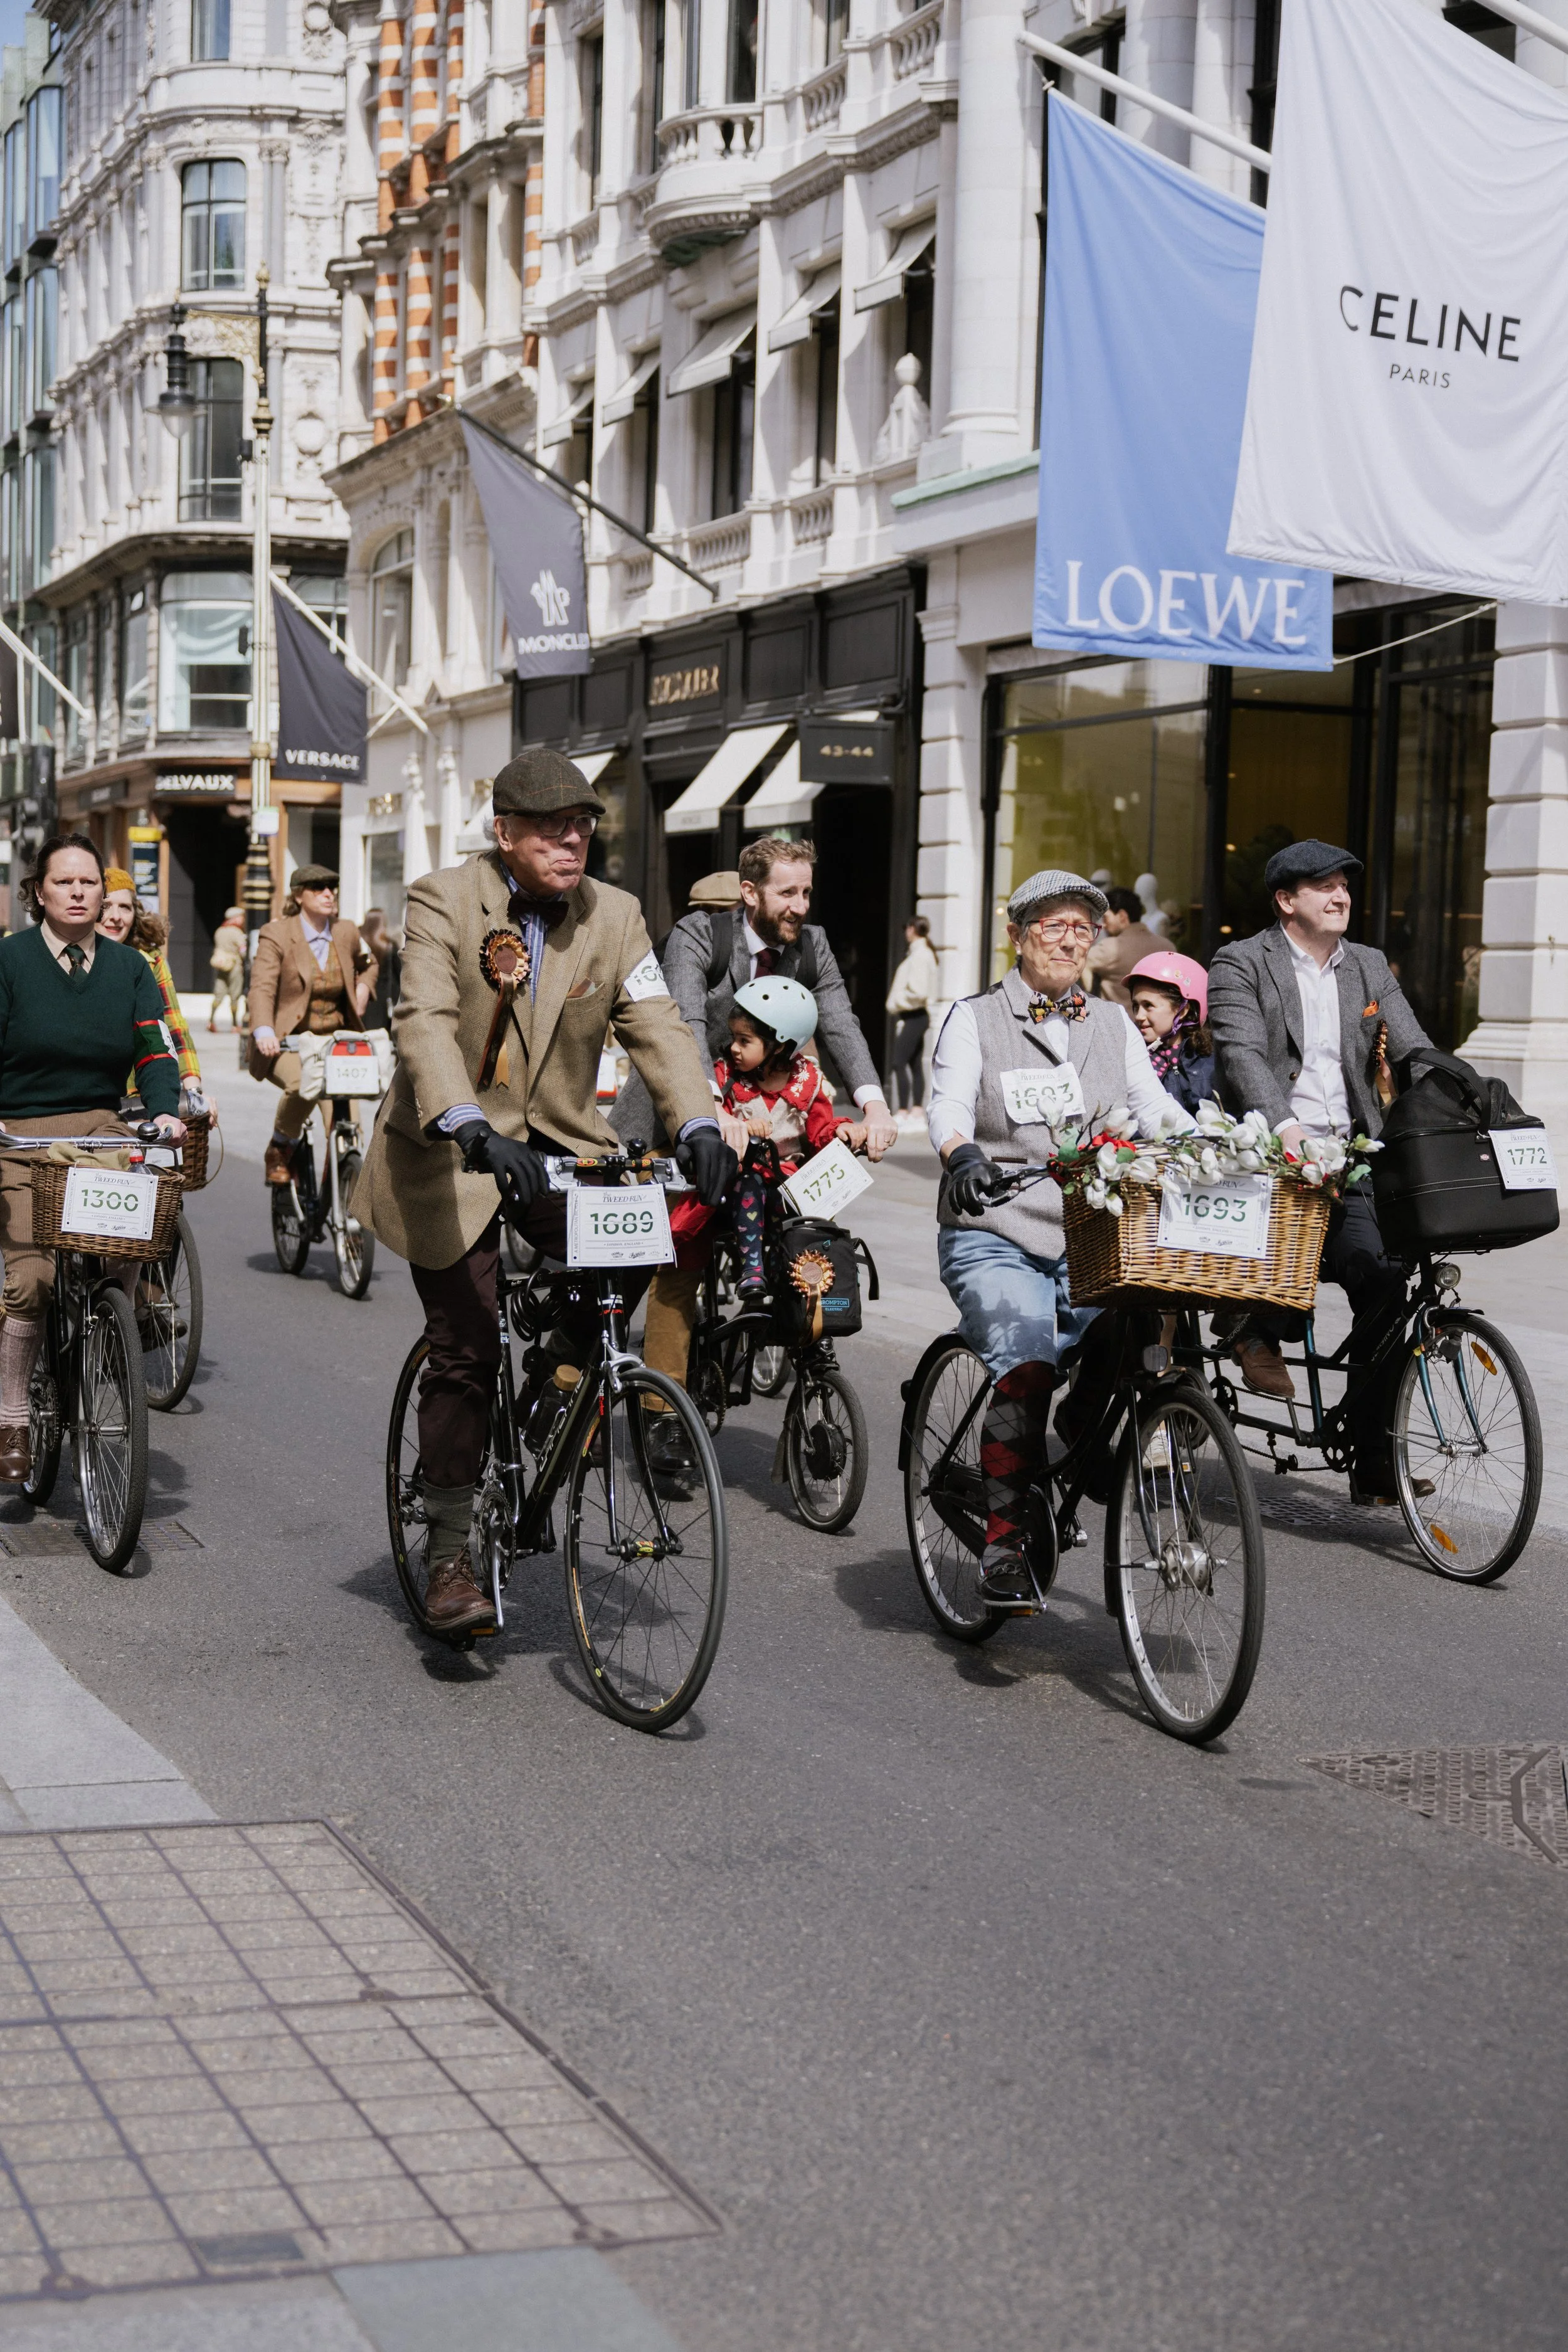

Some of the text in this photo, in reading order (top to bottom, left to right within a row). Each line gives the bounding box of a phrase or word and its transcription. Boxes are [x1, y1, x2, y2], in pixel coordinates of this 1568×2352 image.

[1340, 285, 1520, 363] CELINE
[1389, 363, 1451, 389] PARIS
[1066, 560, 1306, 645] LOEWE
[518, 632, 590, 655] MONCLE
[285, 749, 360, 770] VERSACE
[337, 1067, 368, 1078] 1407
[1507, 1147, 1547, 1165] 1772
[803, 1163, 845, 1202] 1775
[82, 1189, 139, 1211] 1300
[1183, 1193, 1246, 1222] 1693
[590, 1211, 653, 1234] 1689
